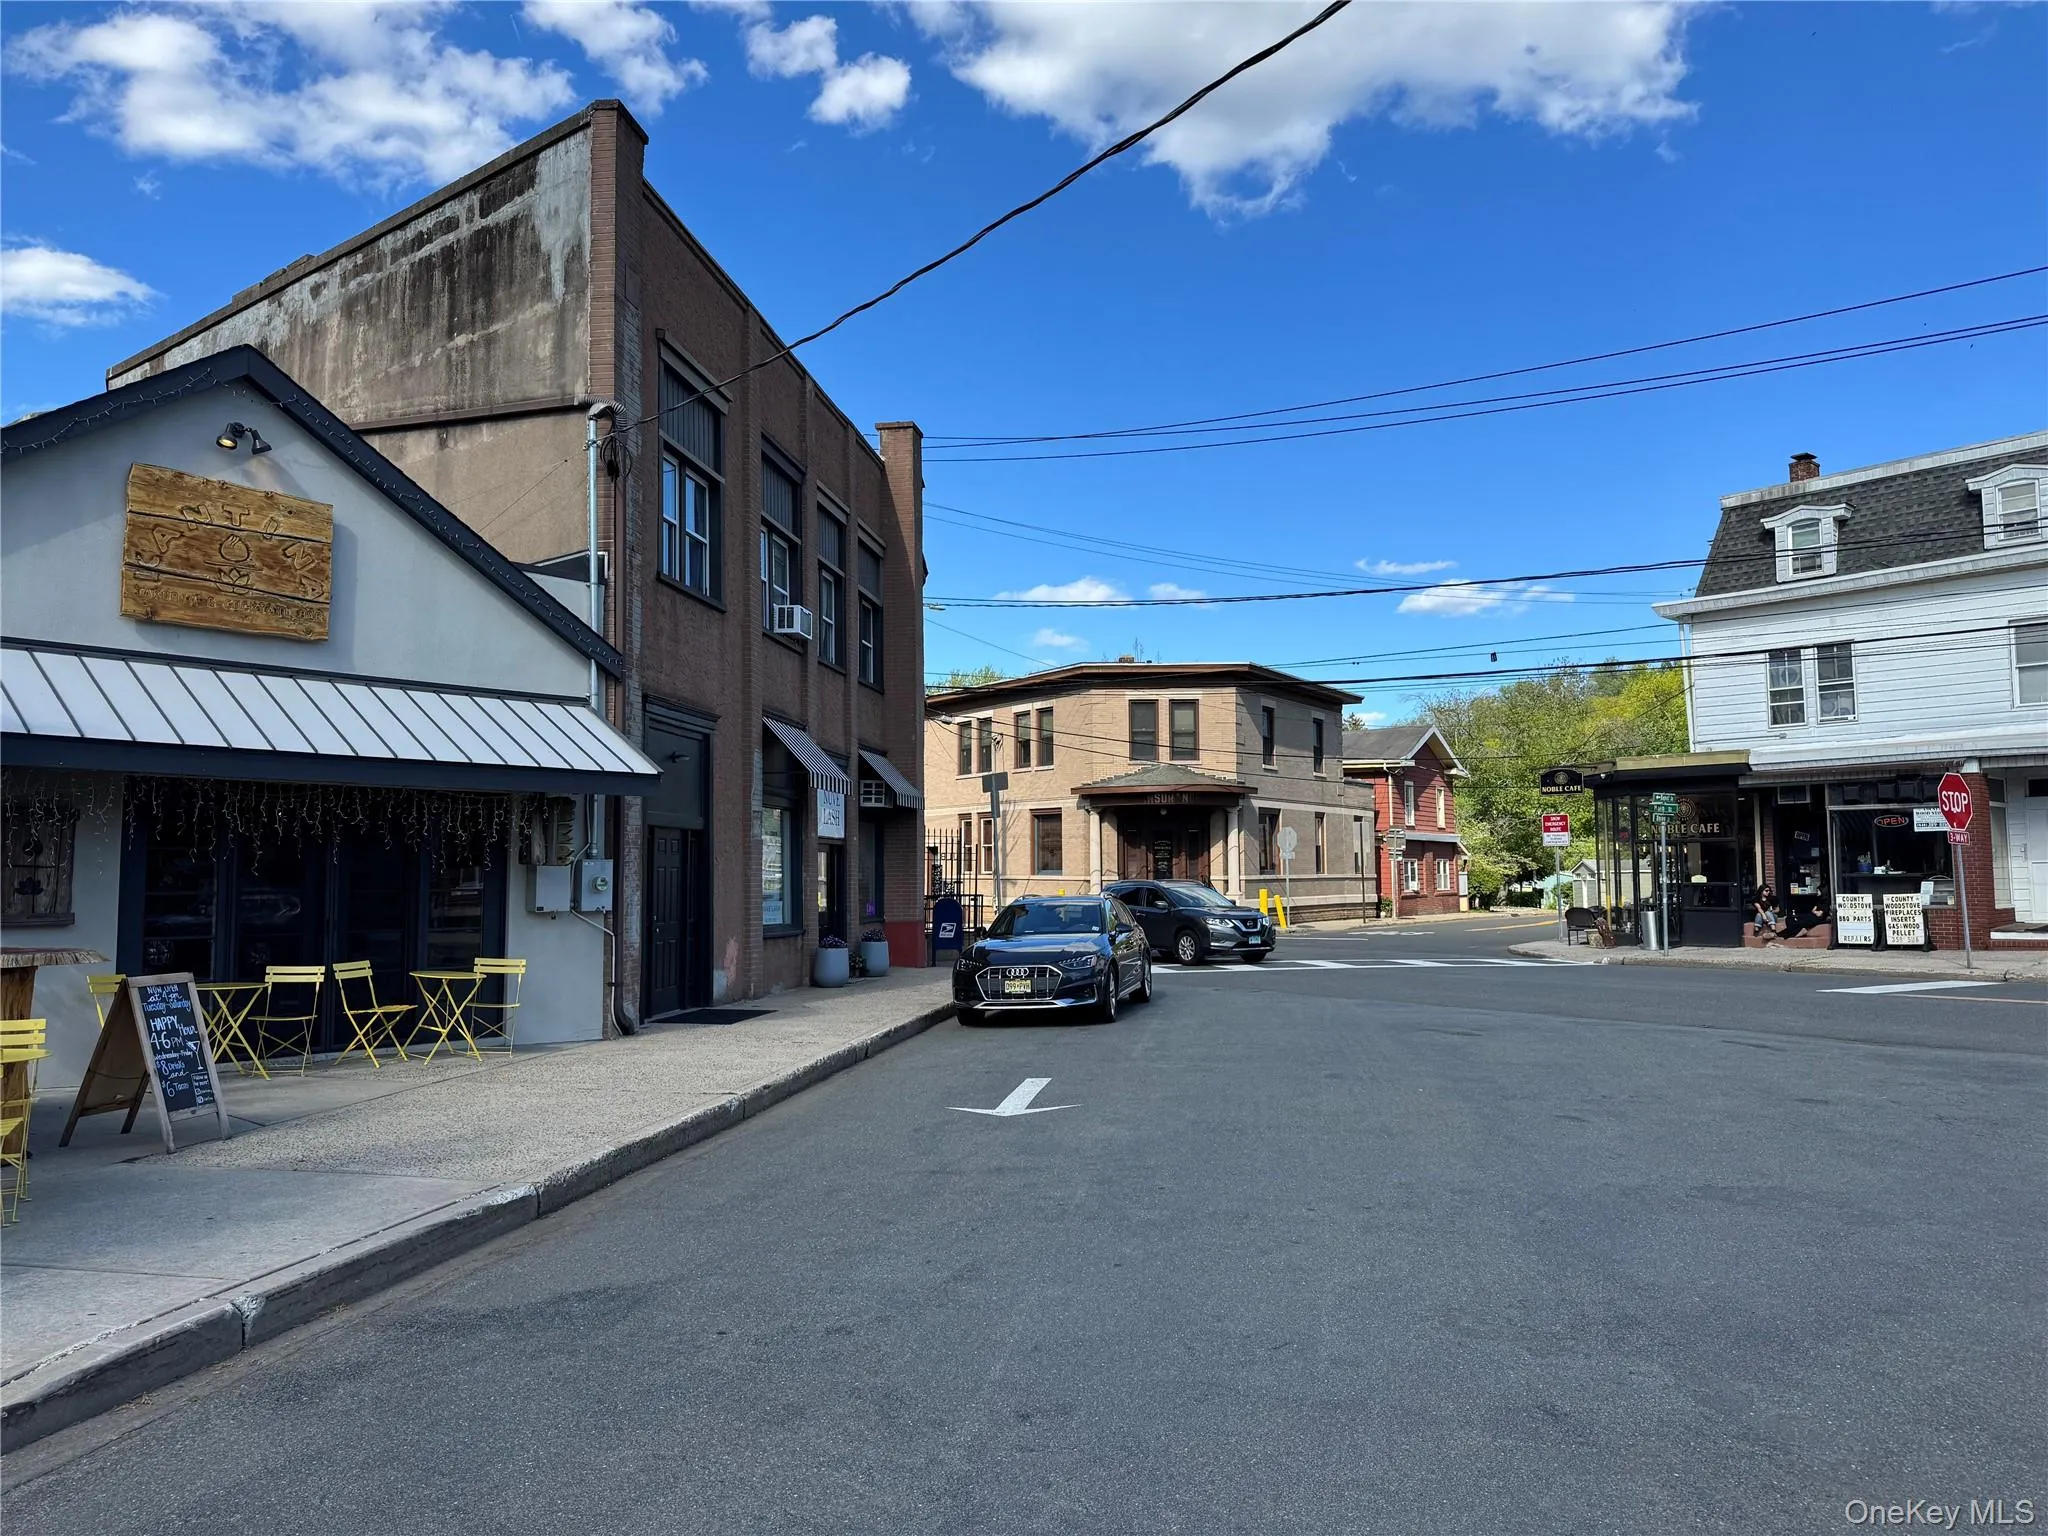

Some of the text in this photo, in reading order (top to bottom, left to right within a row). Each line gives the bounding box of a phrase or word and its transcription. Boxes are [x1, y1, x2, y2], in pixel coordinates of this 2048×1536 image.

[1941, 790, 1969, 813] STOP
[1876, 817, 1905, 826] OPEN
[1690, 823, 1720, 833] CAFE
[1949, 832, 1968, 843] 3-WAY
[149, 1015, 179, 1032] HAPPY
[150, 1031, 171, 1050] 4-6
[168, 1069, 190, 1080] and
